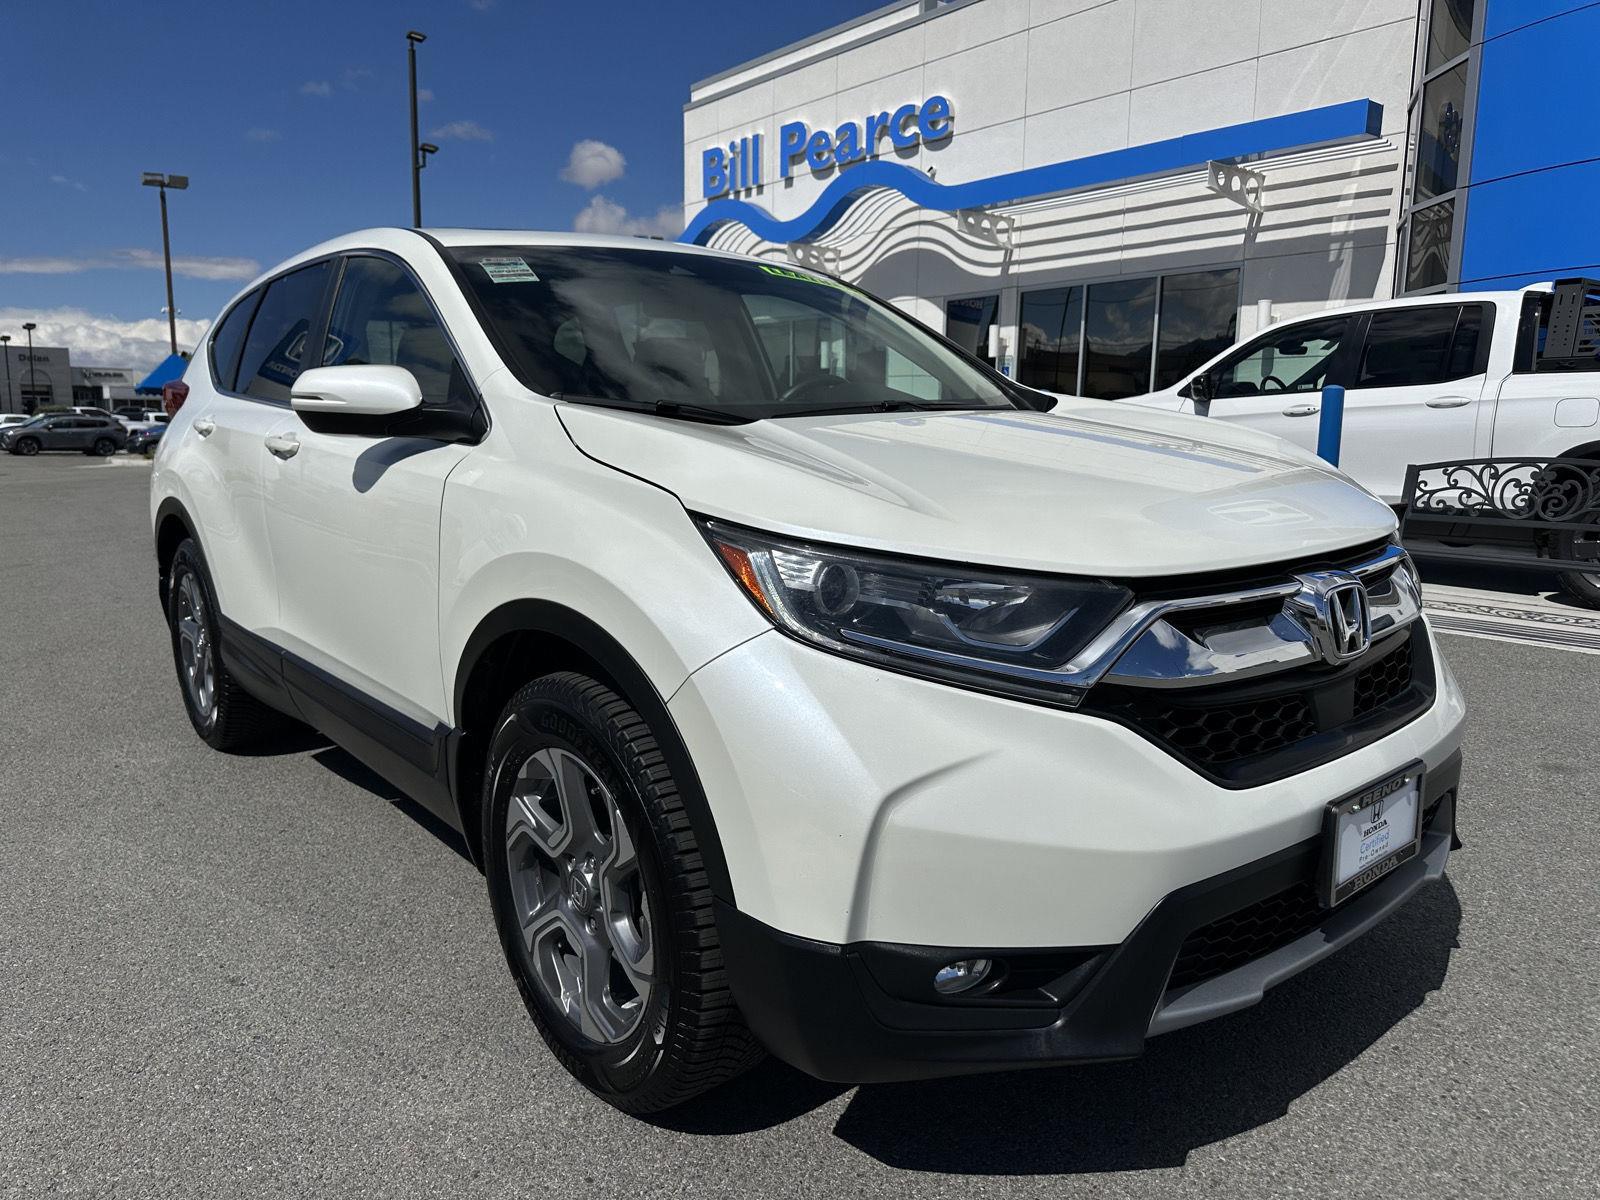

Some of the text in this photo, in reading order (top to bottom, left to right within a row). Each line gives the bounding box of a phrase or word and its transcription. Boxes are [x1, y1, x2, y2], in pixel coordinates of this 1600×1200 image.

[703, 95, 953, 198] Bill Pearce
[1360, 778, 1402, 807] RENO
[1360, 828, 1390, 854] Certified
[1363, 819, 1388, 838] HONDA
[1353, 854, 1399, 891] HONDA
